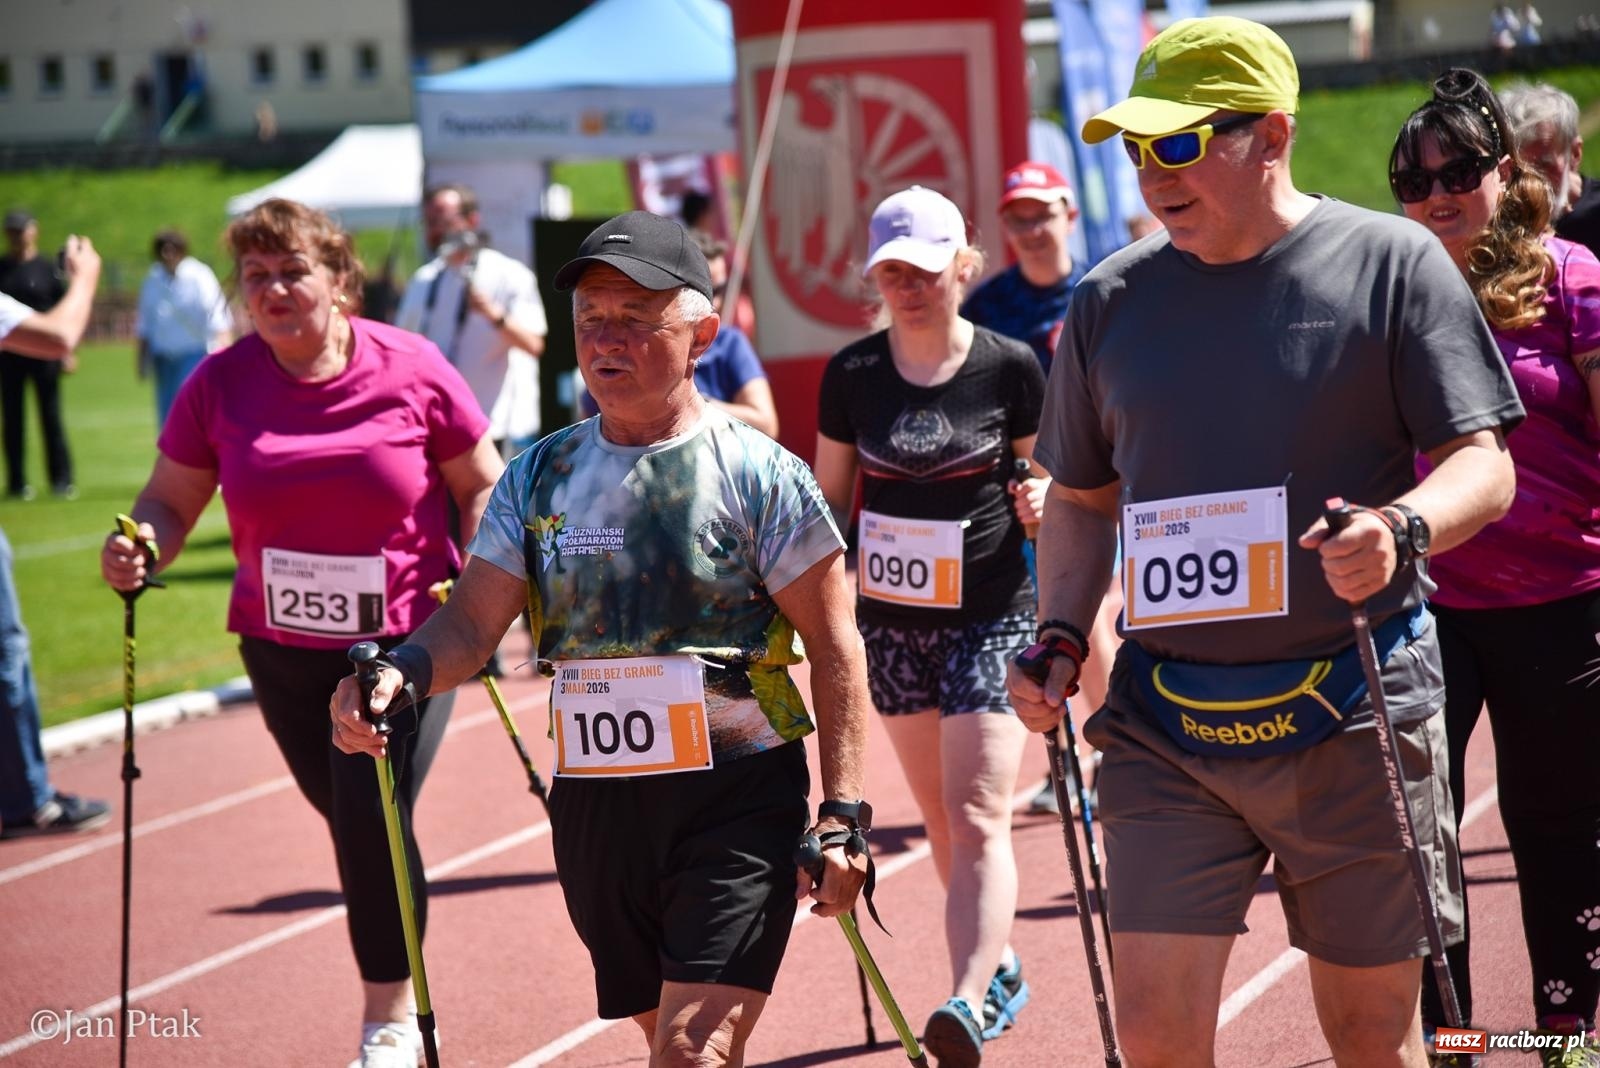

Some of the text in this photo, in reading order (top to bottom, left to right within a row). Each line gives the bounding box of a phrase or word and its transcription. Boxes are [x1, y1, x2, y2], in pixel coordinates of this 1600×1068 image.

[1134, 500, 1248, 526] XVIII BIEG BEZ GRANIC
[1134, 522, 1190, 541] 3MAJA2026
[868, 552, 929, 589] 090
[1143, 549, 1239, 603] 099
[281, 589, 349, 623] 253
[560, 682, 610, 694] 3MAJA2026
[561, 664, 664, 681] XVIII BIEG BEZ GRANIC
[574, 710, 655, 756] 100
[1180, 712, 1298, 745] Reebok
